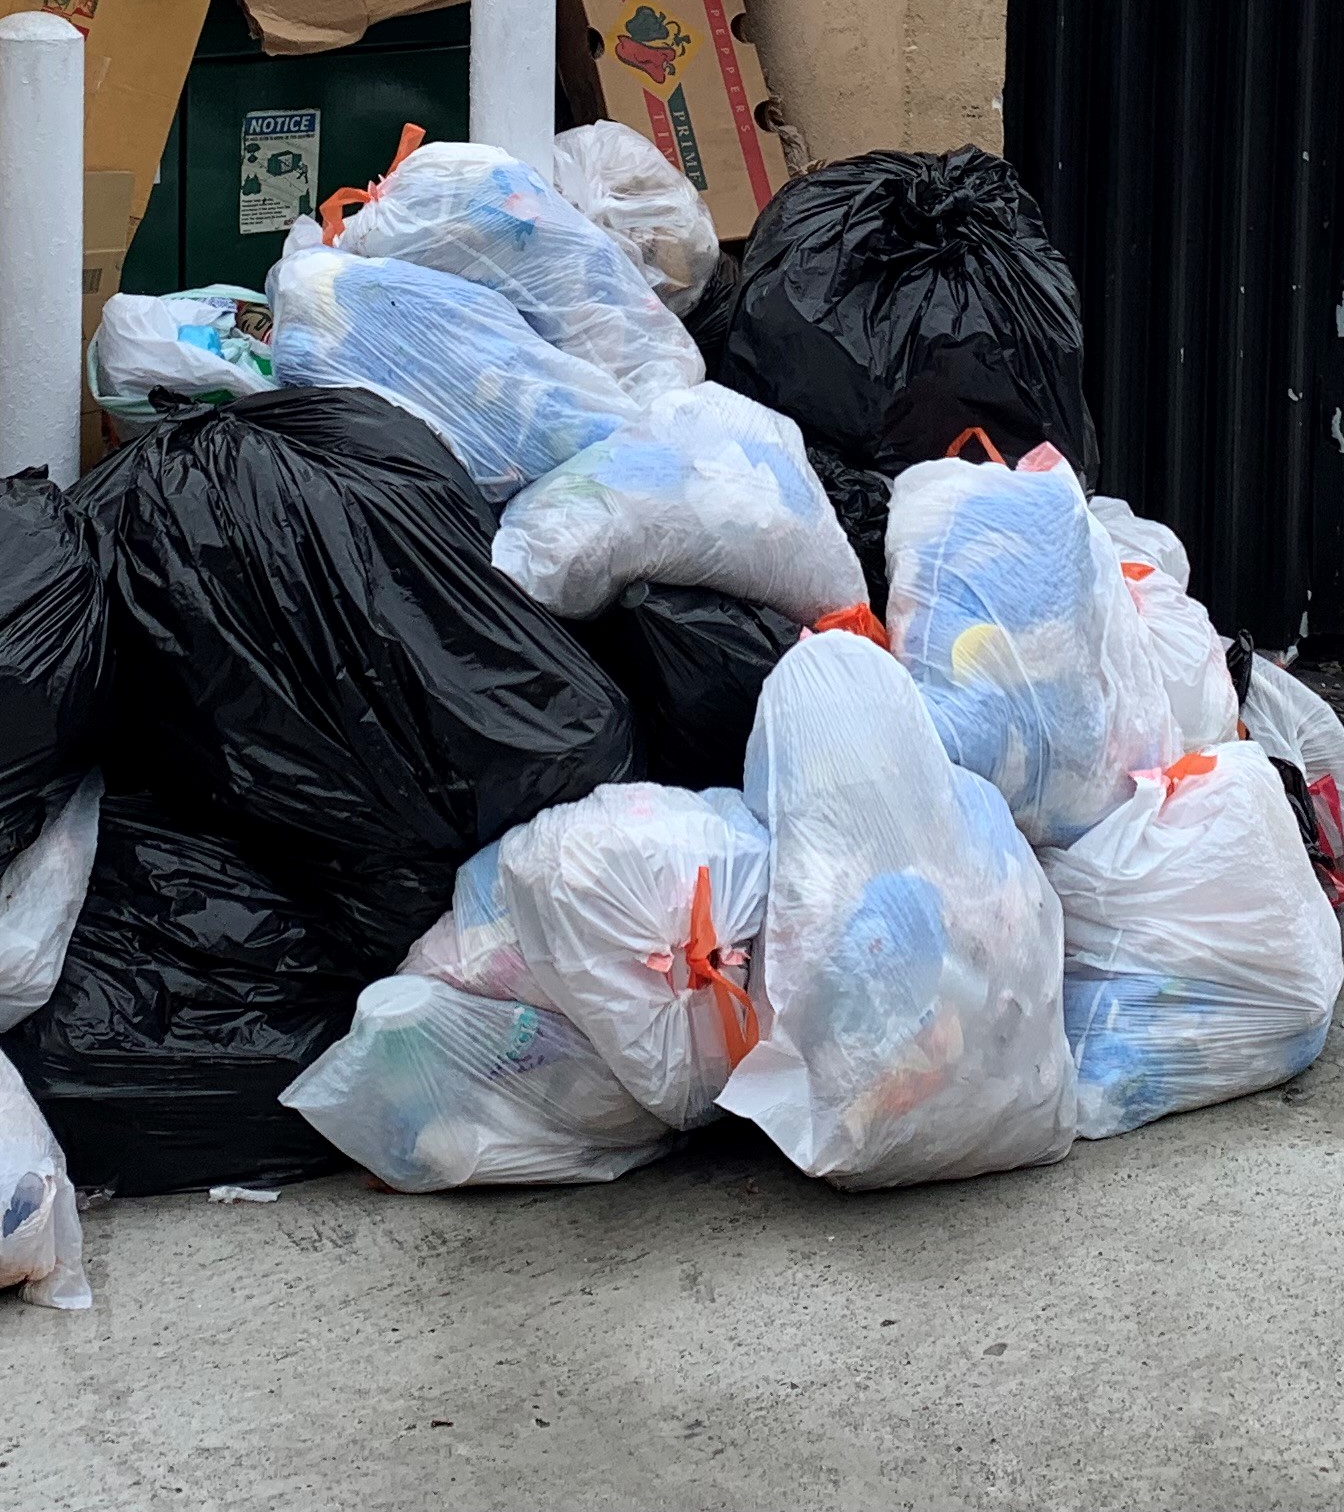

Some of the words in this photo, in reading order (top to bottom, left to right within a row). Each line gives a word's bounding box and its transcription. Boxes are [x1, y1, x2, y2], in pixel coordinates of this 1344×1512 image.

[710, 9, 751, 133] PEPPERS
[249, 115, 311, 134] NOTICE
[653, 113, 675, 162] TIM
[672, 111, 702, 183] PRIME
